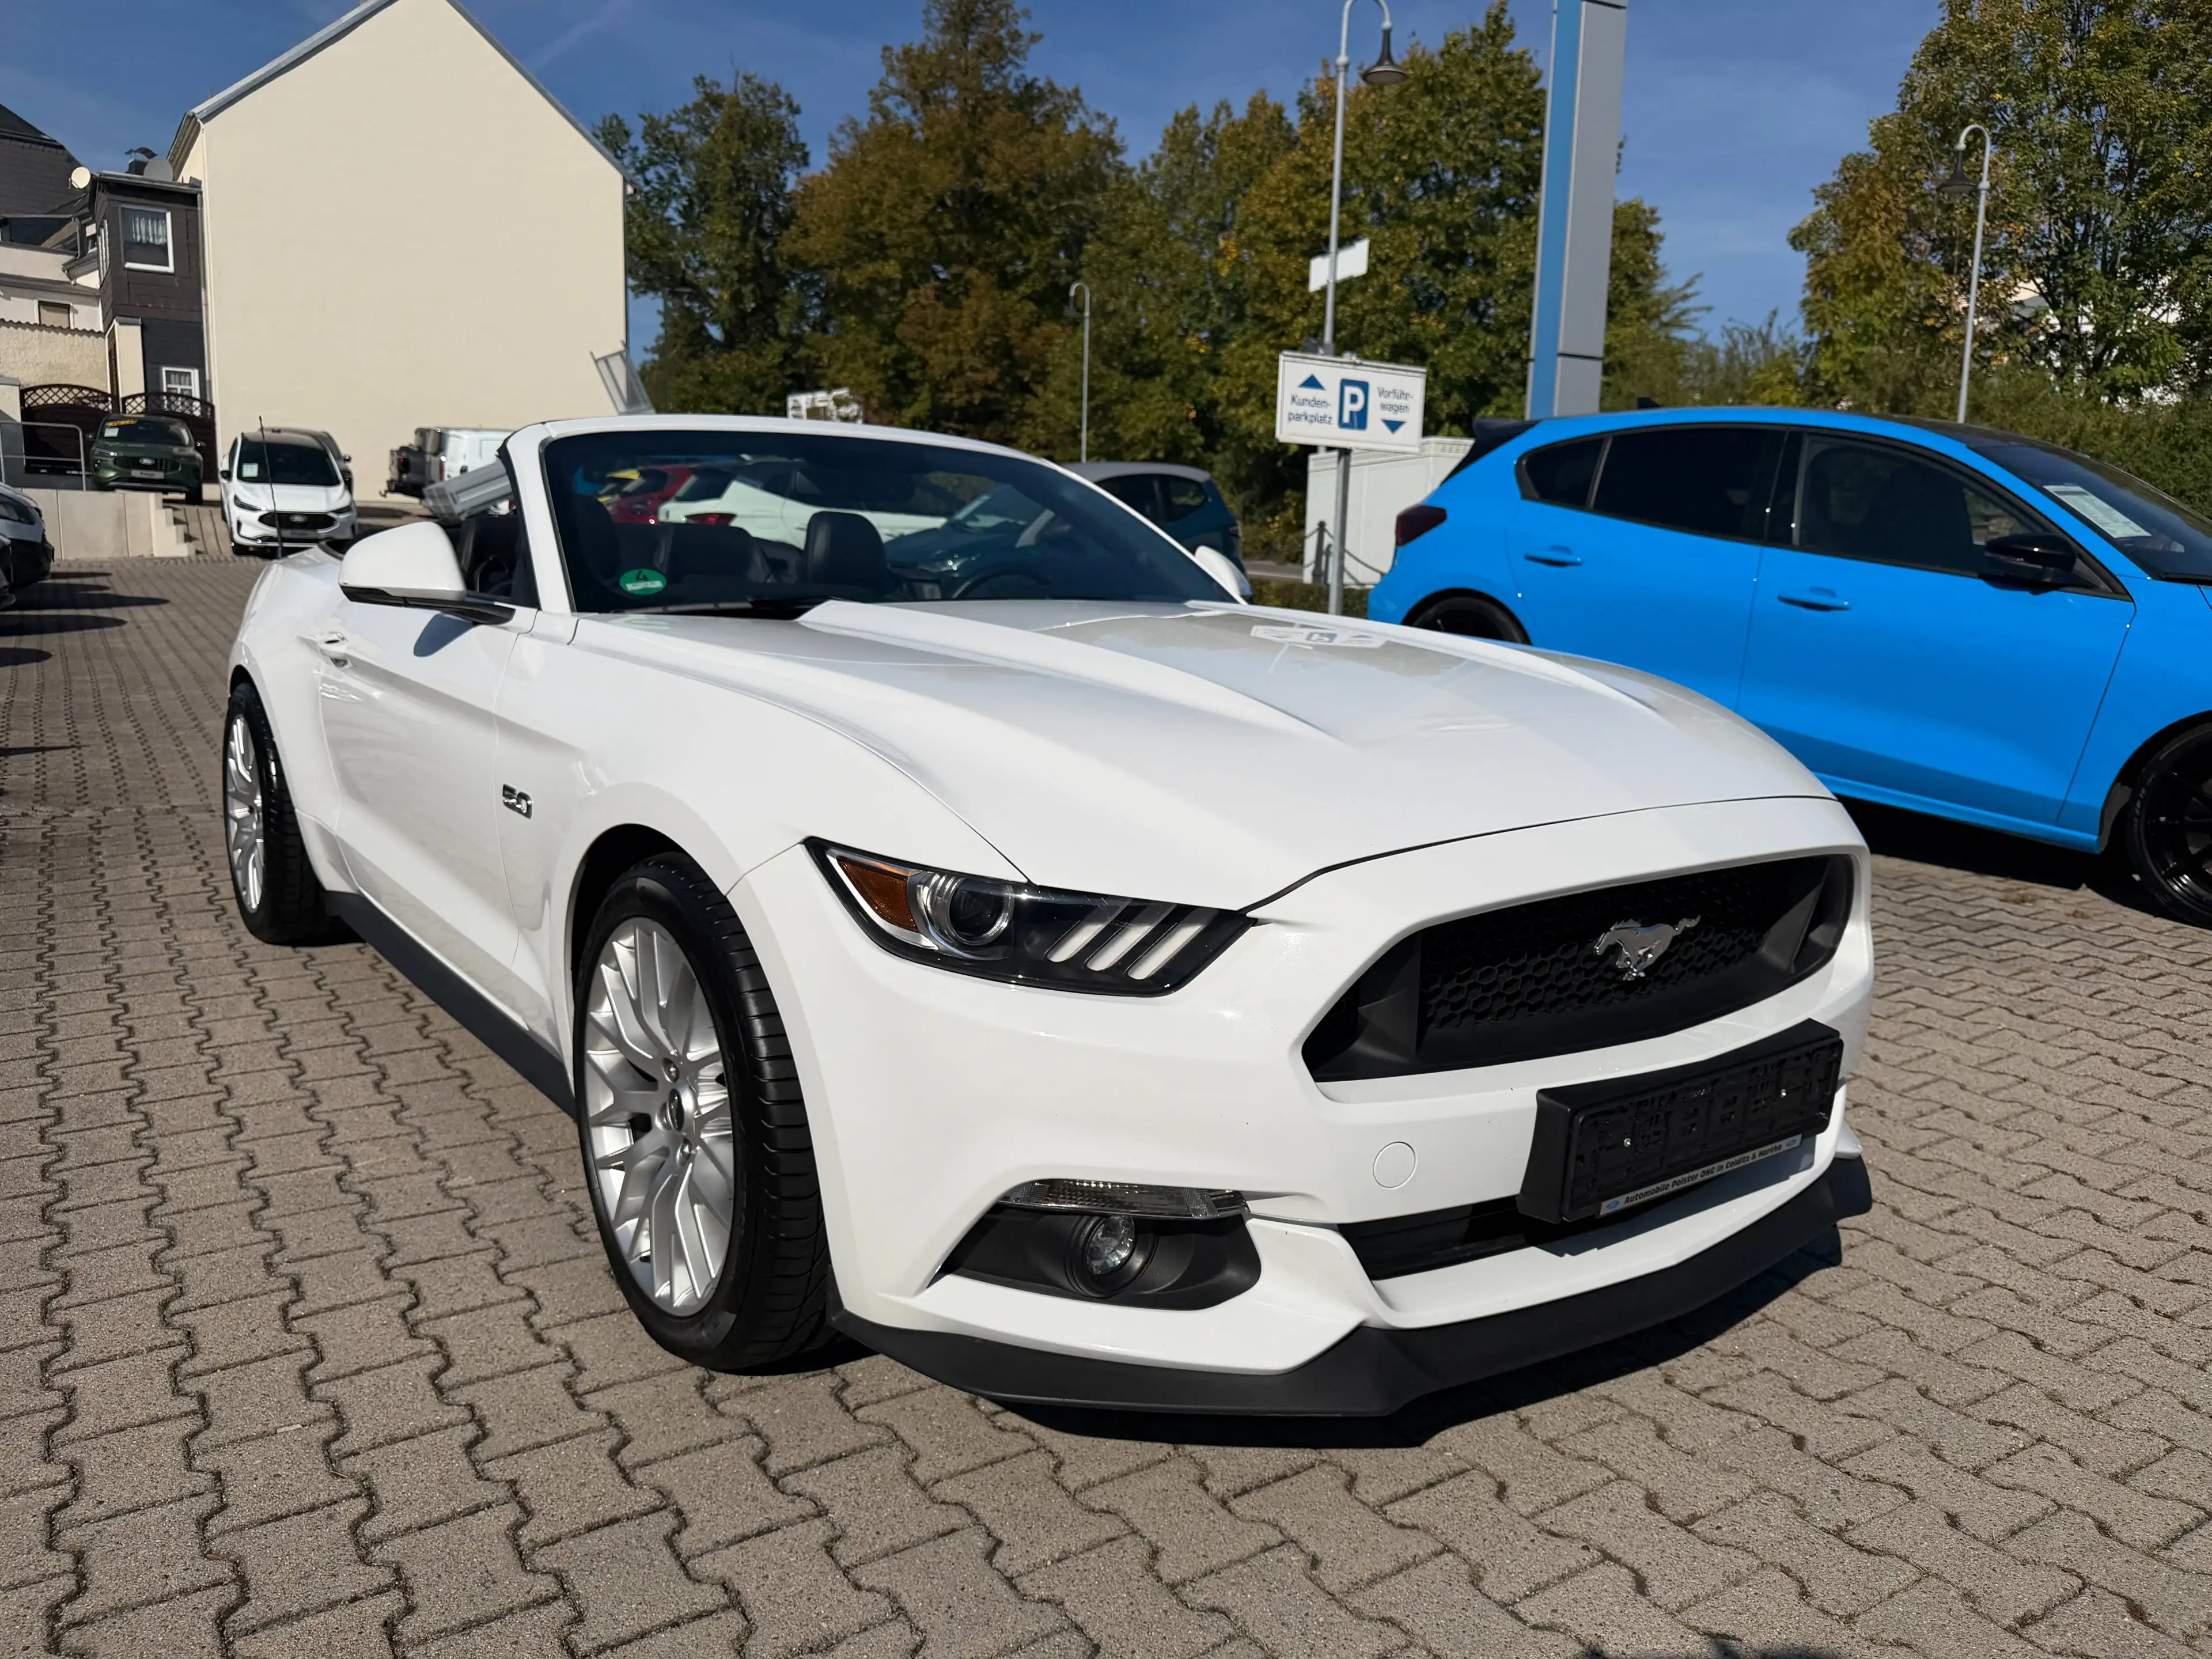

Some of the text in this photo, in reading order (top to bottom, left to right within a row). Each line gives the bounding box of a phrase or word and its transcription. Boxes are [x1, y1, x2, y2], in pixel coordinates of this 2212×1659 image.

[1290, 394, 1331, 409] Kunden-
[1343, 385, 1365, 424] P
[1380, 403, 1410, 415] wagen
[1287, 411, 1333, 425] parkplatz
[636, 570, 648, 581] 4
[1624, 1183, 1670, 1204] Automobile
[1717, 1164, 1724, 1173] in
